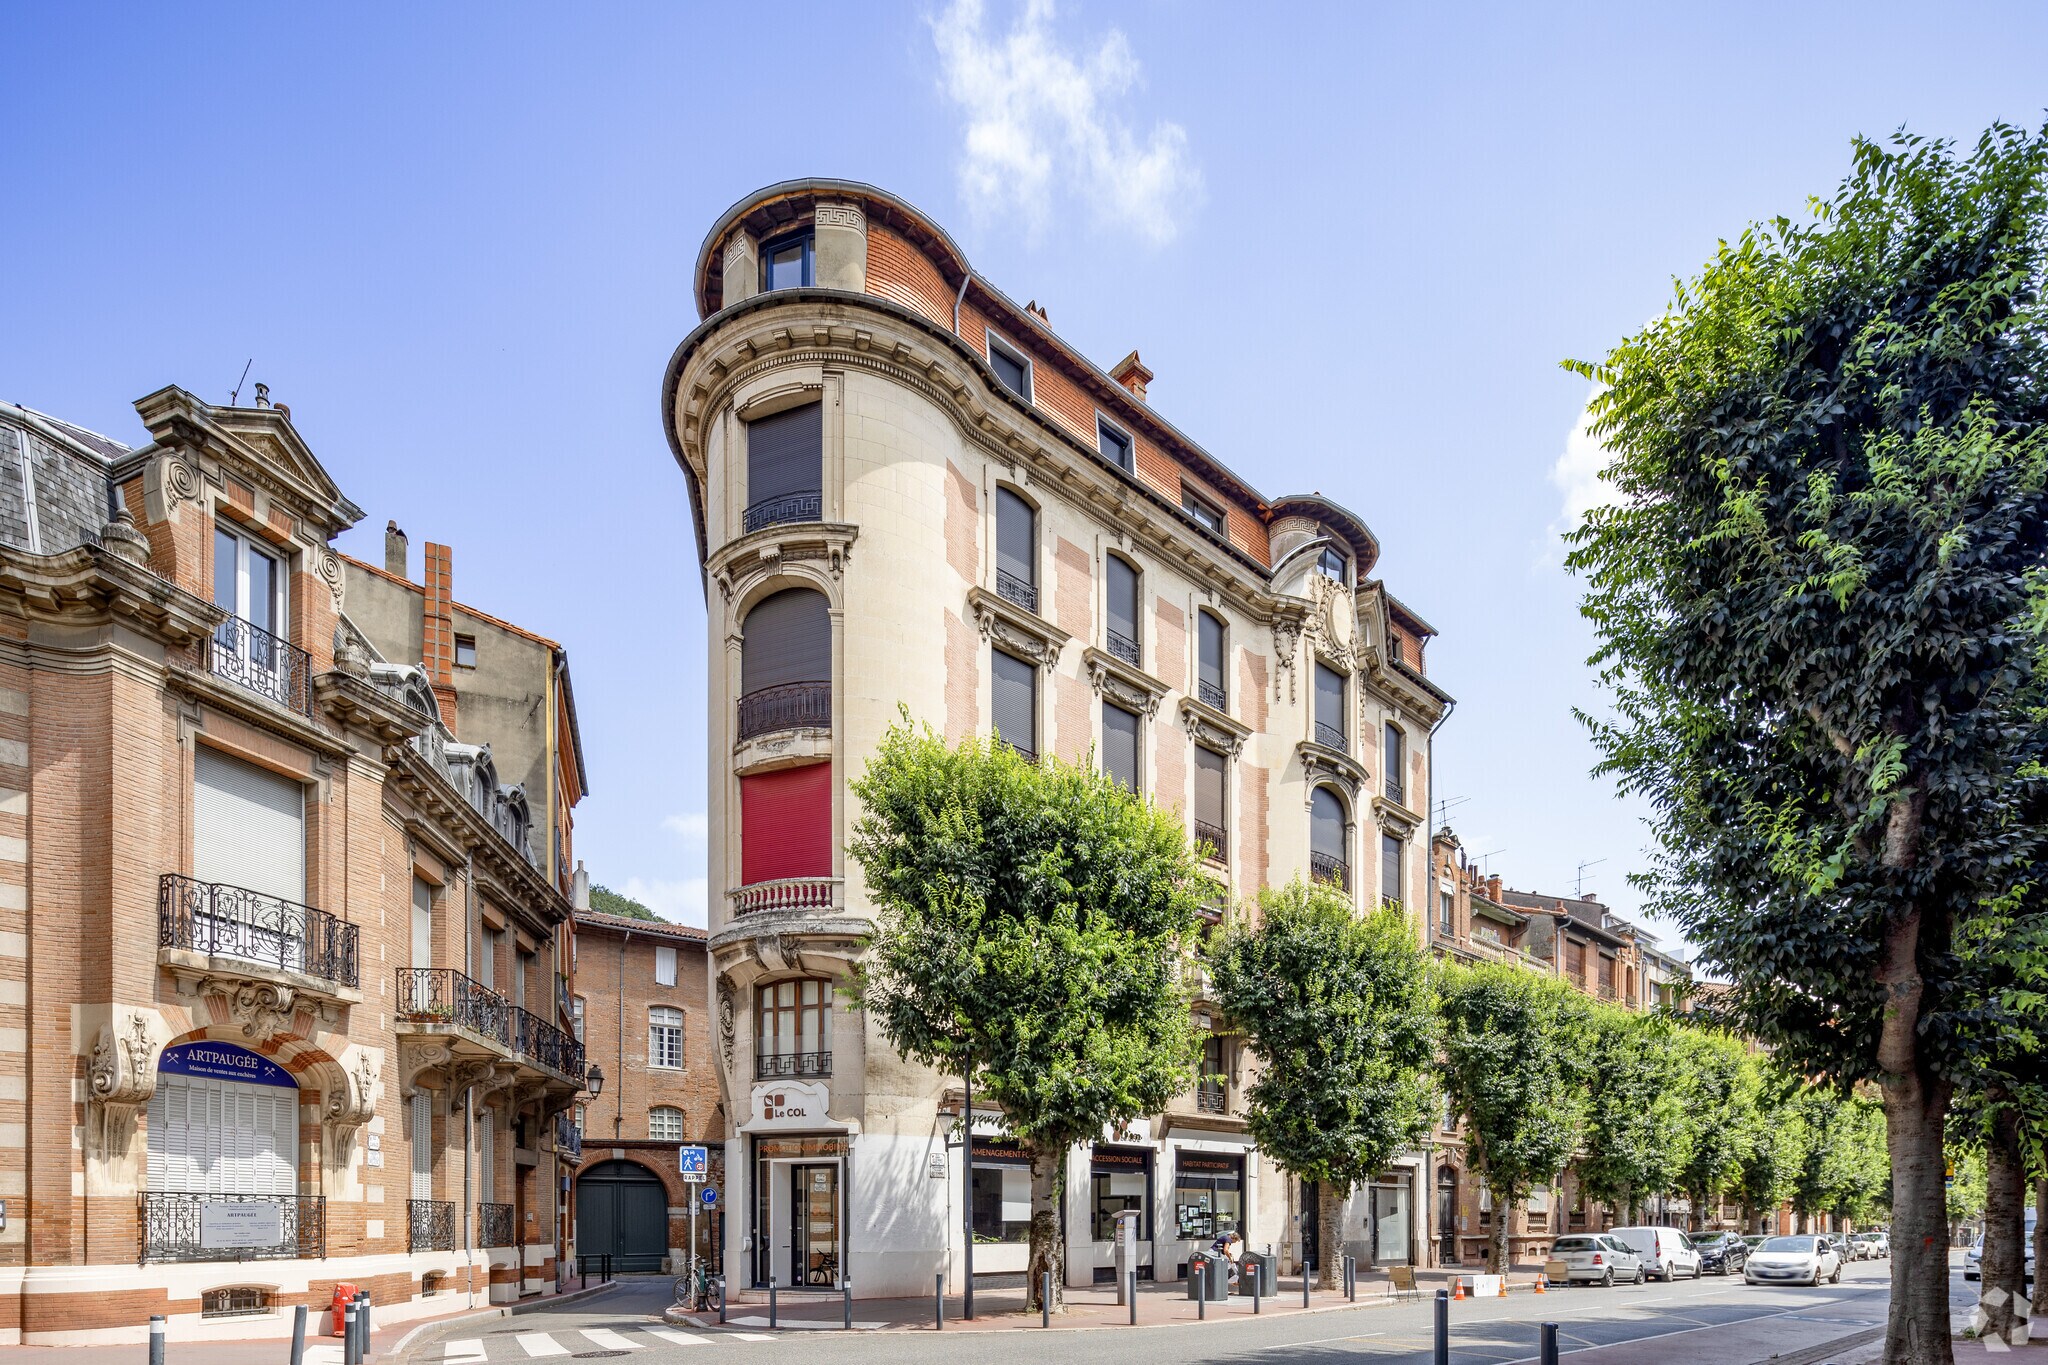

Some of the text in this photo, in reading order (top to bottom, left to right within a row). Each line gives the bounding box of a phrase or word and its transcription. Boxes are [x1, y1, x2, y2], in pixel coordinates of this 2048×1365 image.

[187, 1049, 258, 1069] ARTPAUGÉE
[189, 1064, 206, 1073] Maison
[237, 1071, 256, 1079] enchères
[775, 1108, 807, 1118] Le COL
[759, 1143, 805, 1152] PROMOTION
[972, 1148, 1021, 1158] AMENAGEMENT
[1121, 1156, 1142, 1164] SOCIALE
[1202, 1161, 1230, 1169] PARTICIPATIF
